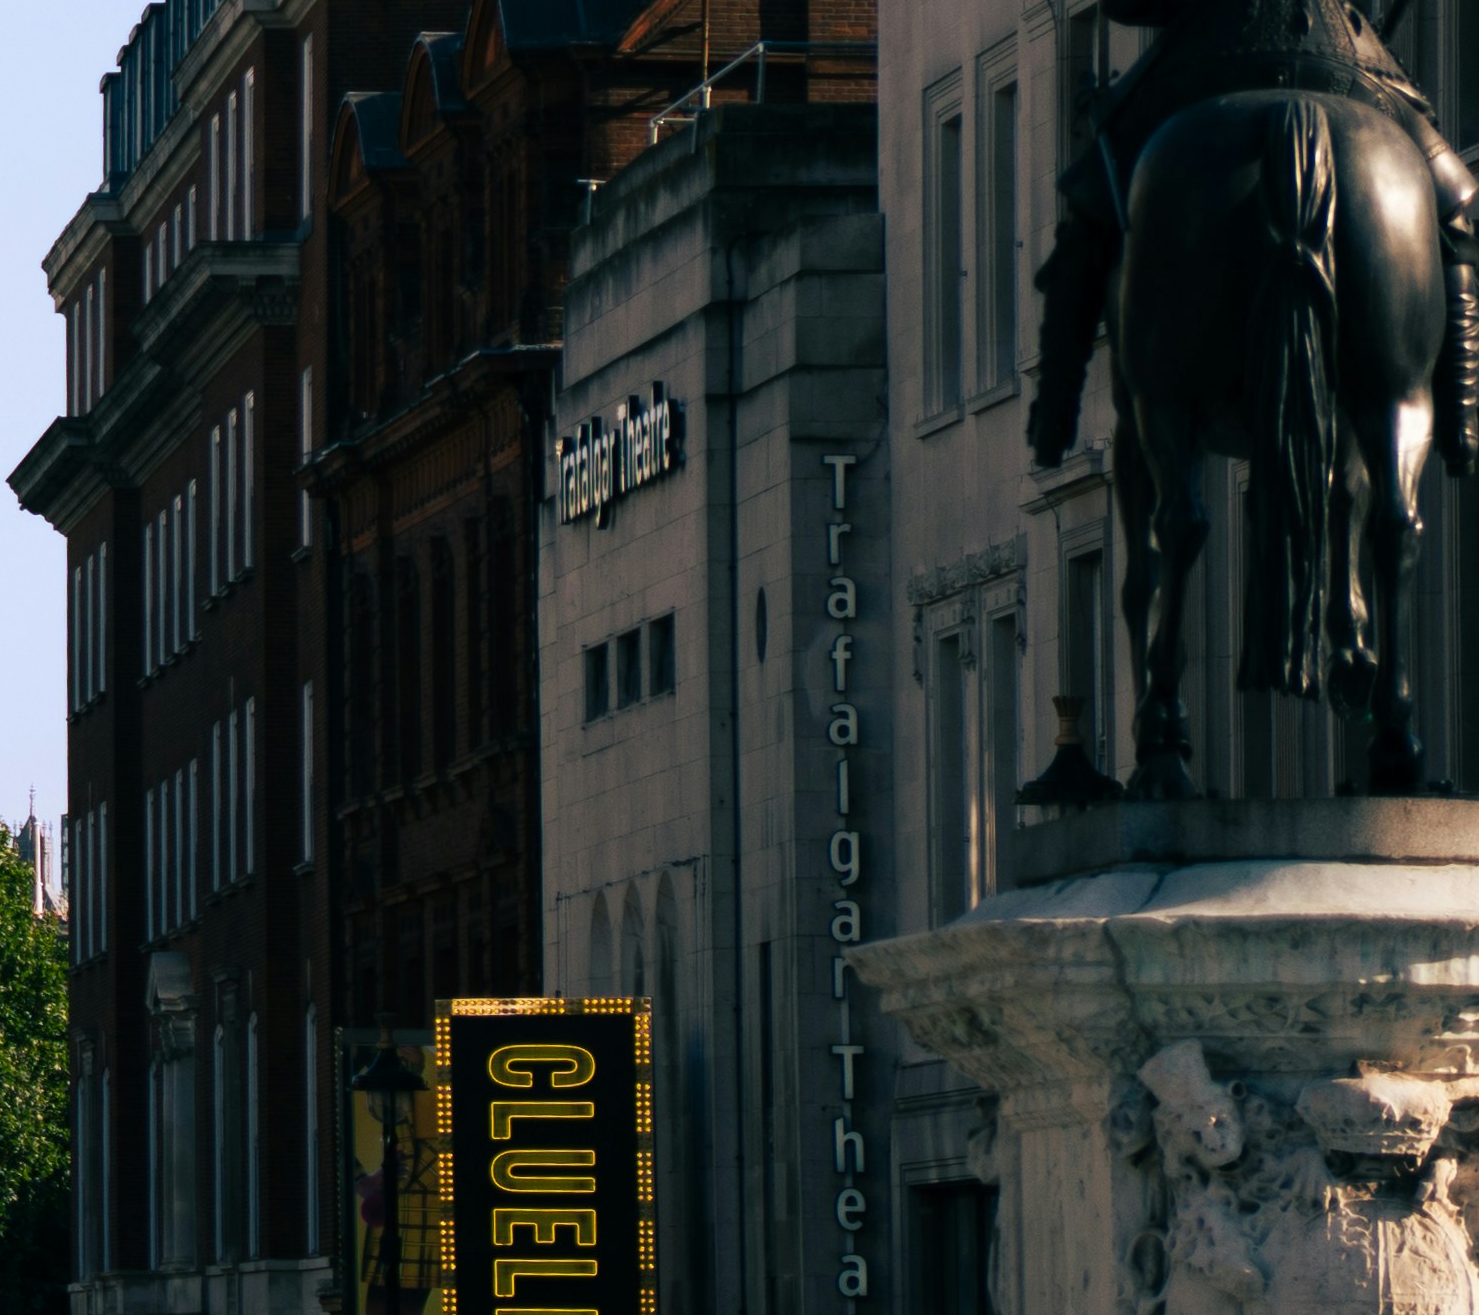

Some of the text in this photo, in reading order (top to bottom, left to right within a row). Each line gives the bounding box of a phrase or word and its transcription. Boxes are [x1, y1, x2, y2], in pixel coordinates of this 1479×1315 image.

[555, 383, 674, 528] Trafalgar Theatre
[822, 454, 862, 1000] Trafalgar
